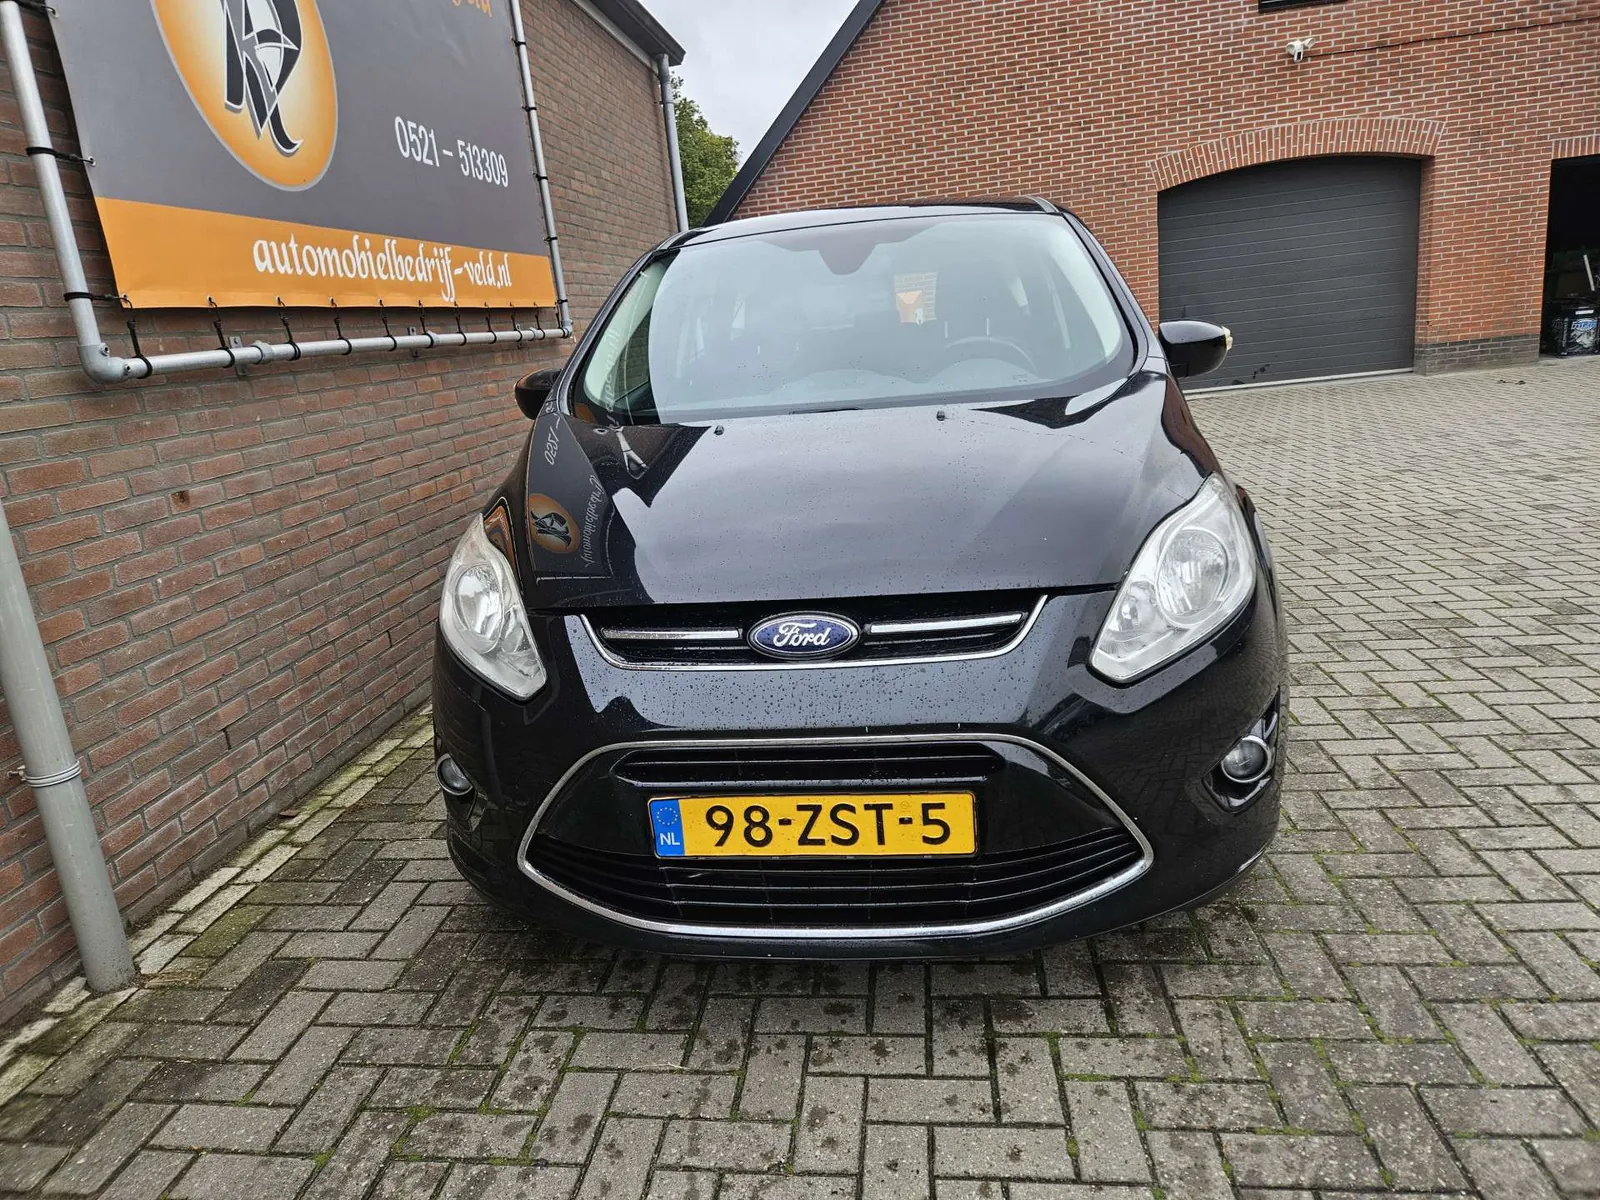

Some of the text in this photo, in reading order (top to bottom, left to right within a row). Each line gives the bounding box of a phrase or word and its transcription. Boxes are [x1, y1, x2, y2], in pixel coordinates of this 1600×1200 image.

[394, 116, 440, 168] 0521
[456, 139, 509, 188] 513309
[252, 232, 513, 303] automobielbedrijf-veld.nl
[773, 621, 831, 648] Ford
[659, 802, 951, 848] NL 98-ZST-5
